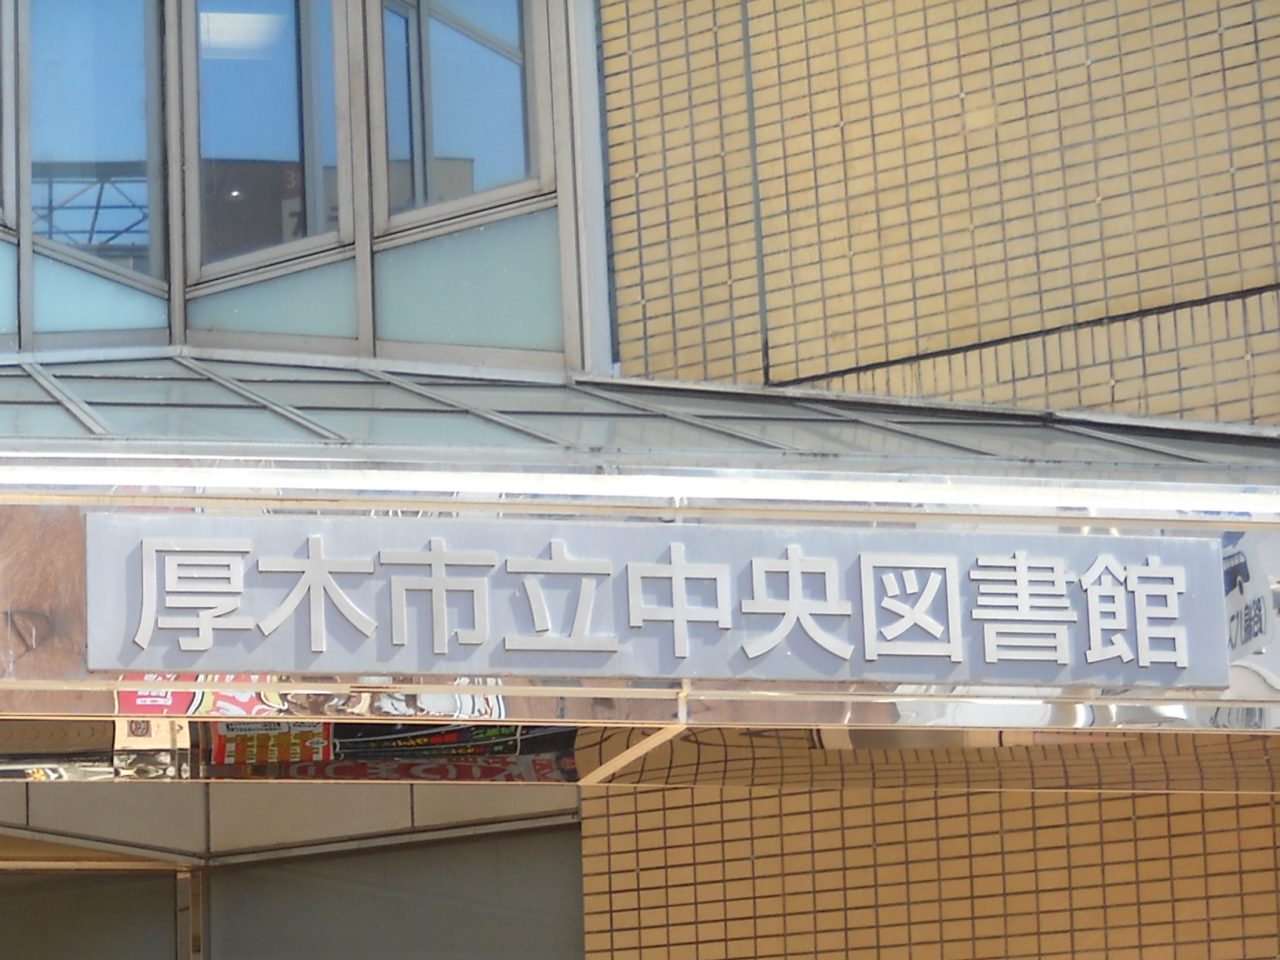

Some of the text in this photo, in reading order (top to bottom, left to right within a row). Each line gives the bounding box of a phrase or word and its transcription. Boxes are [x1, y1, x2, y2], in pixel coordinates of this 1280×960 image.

[132, 534, 1189, 669] 厚木市立中央図書館
